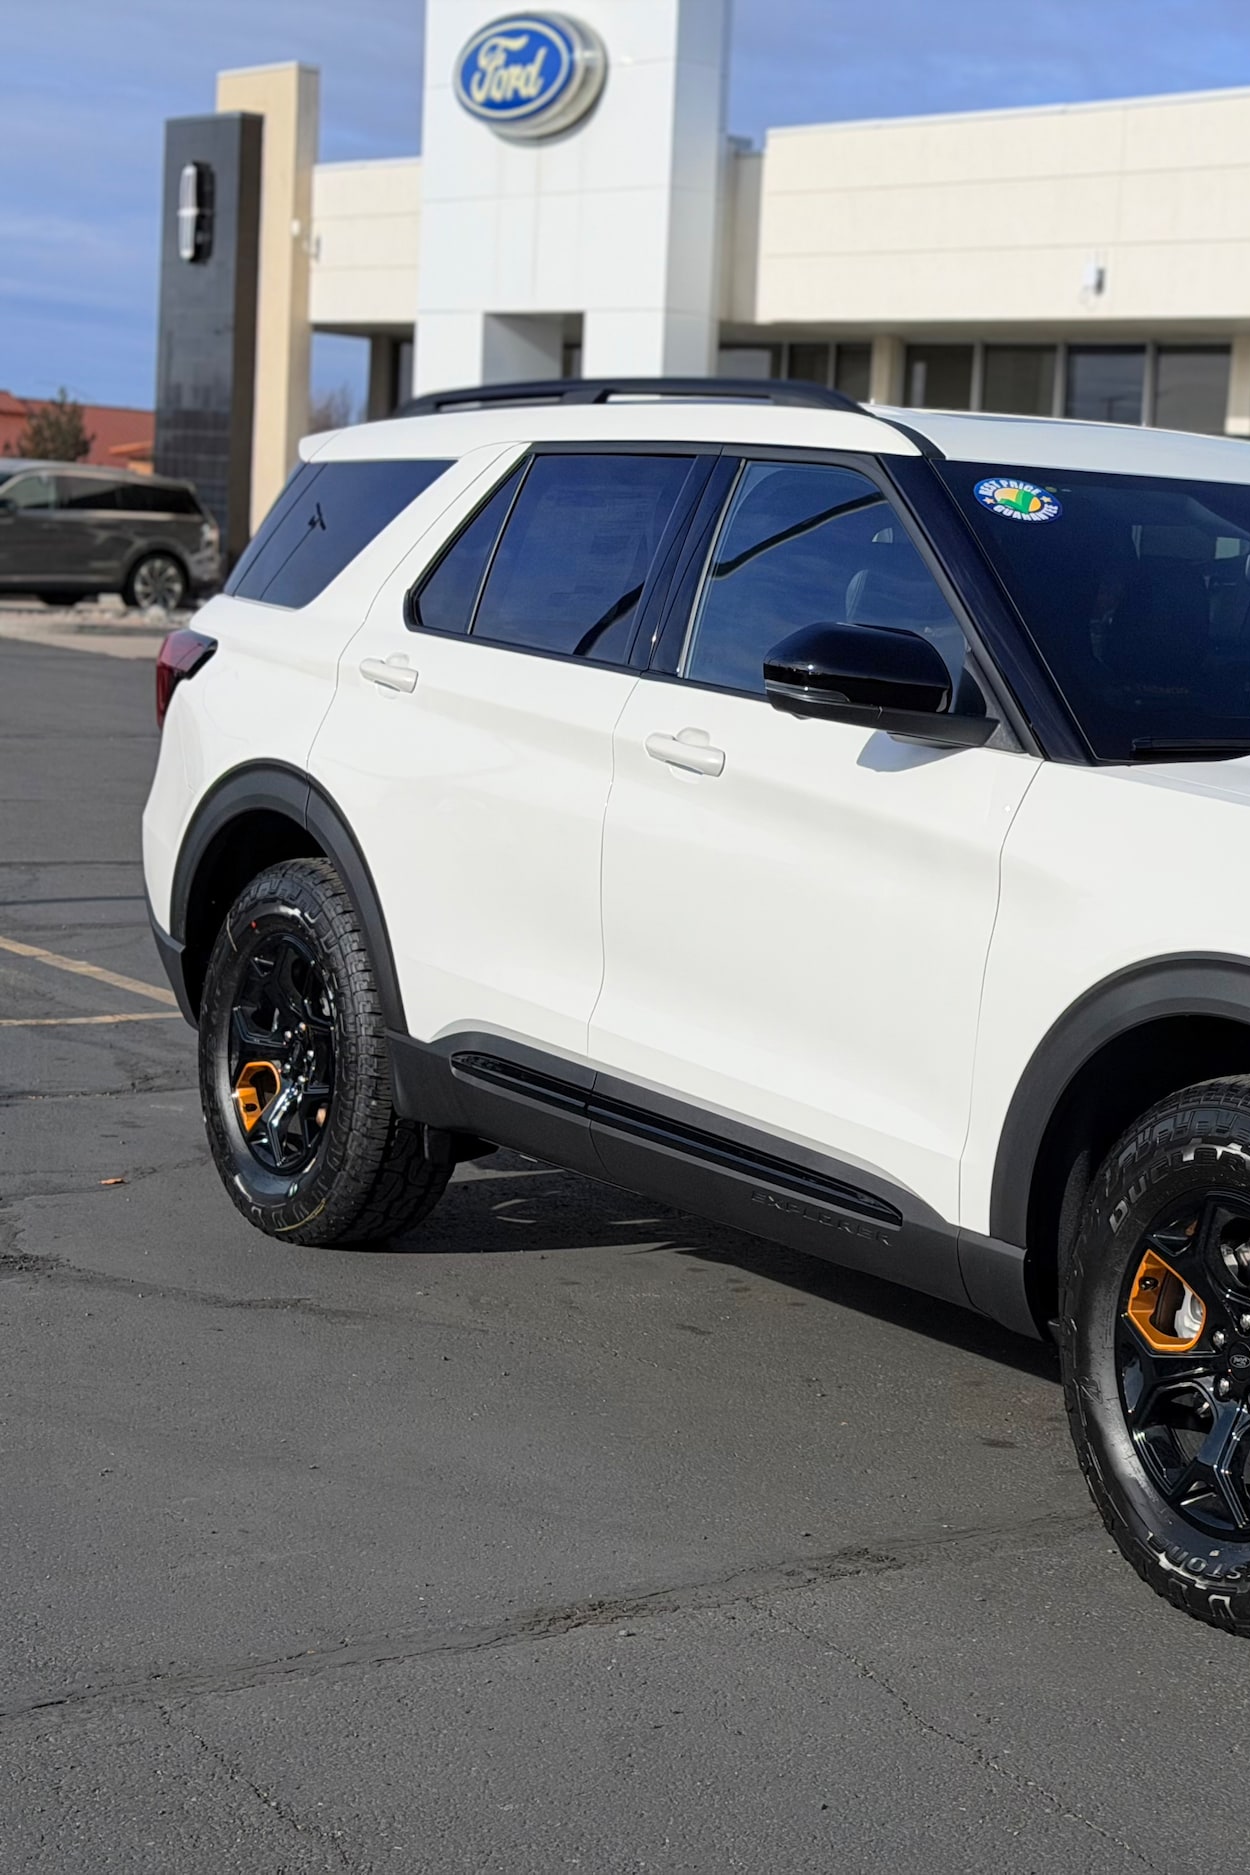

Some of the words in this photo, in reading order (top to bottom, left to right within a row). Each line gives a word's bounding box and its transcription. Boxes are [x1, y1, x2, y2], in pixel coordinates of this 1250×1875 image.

[470, 33, 548, 104] Ford
[978, 480, 1002, 497] BEST
[999, 479, 1042, 496] PRICE
[992, 503, 1059, 522] GUARANTEE
[751, 1190, 893, 1248] EXPLORER
[1108, 1147, 1247, 1237] DUELER
